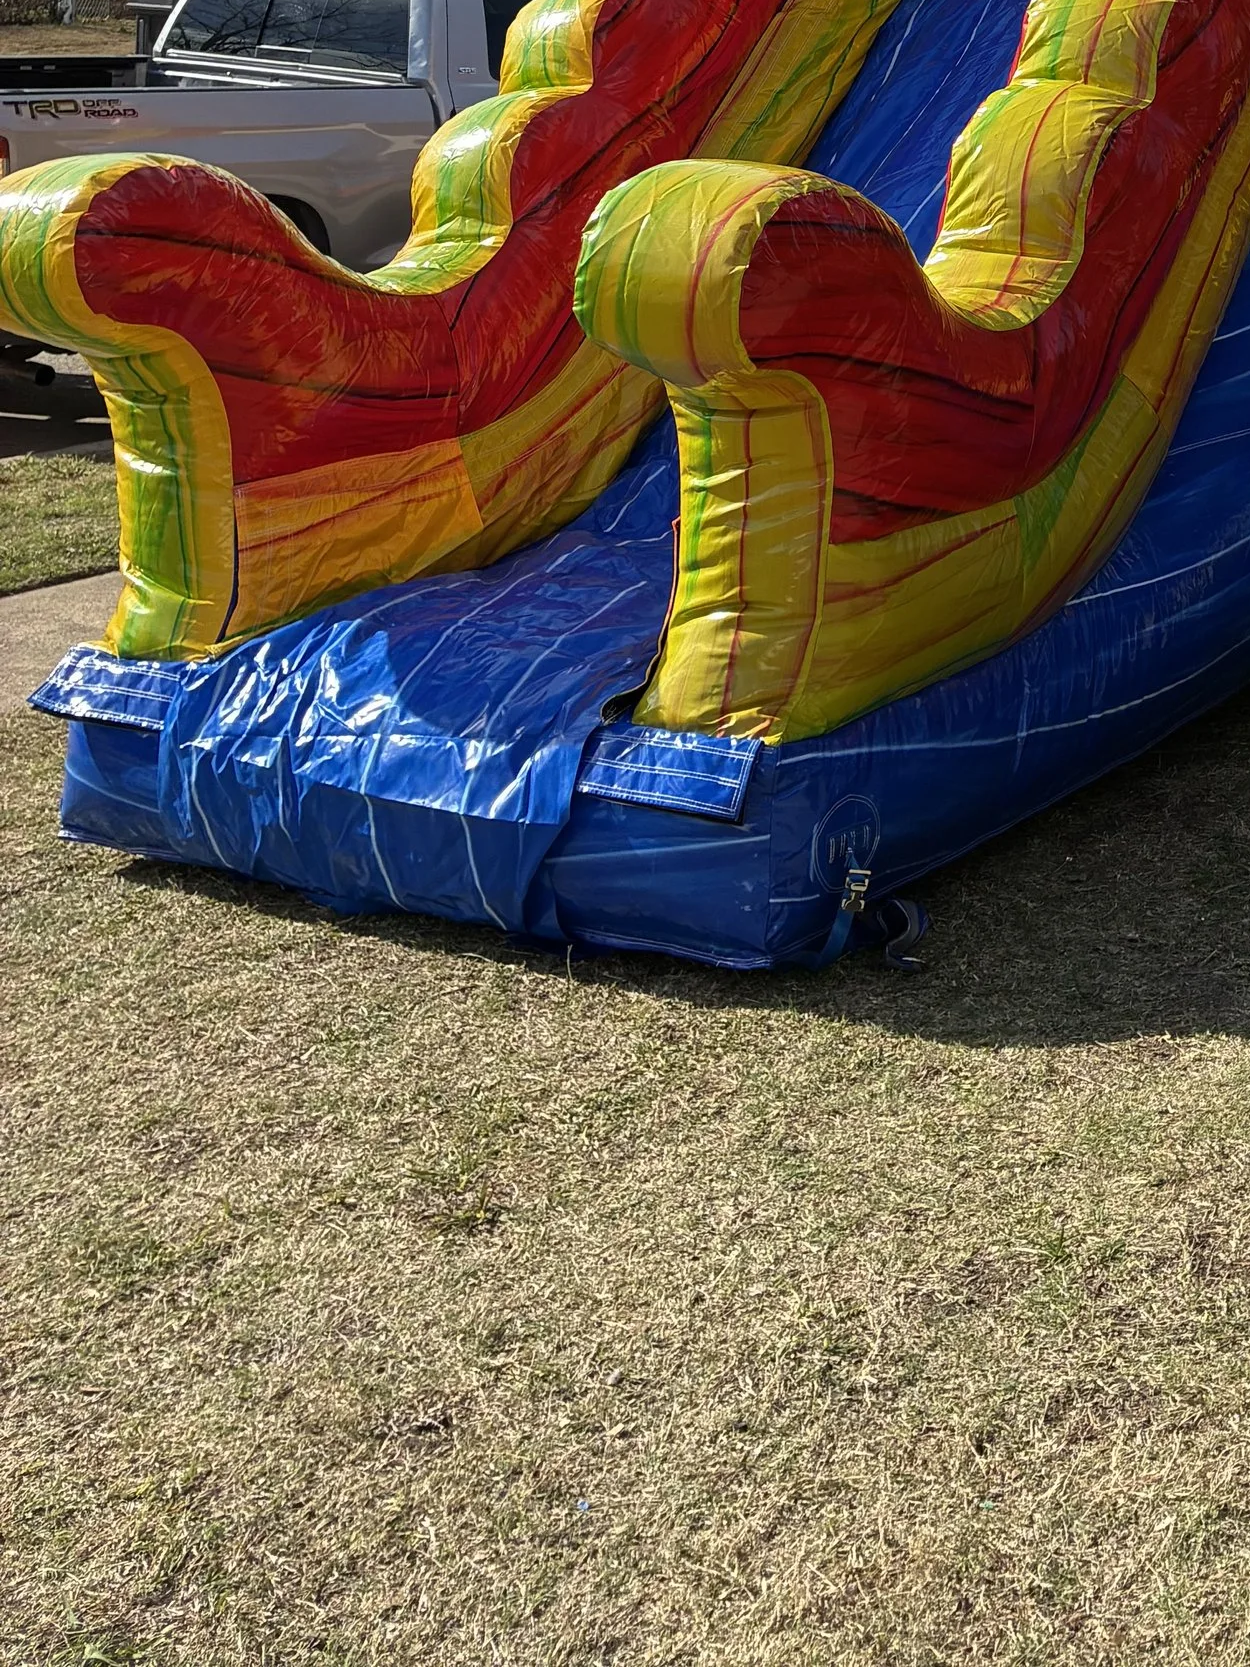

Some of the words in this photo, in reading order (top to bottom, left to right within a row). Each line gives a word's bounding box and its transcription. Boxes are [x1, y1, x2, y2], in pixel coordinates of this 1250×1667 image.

[82, 99, 121, 108] OFF
[2, 99, 81, 120] TRD
[84, 109, 138, 119] ROAD
